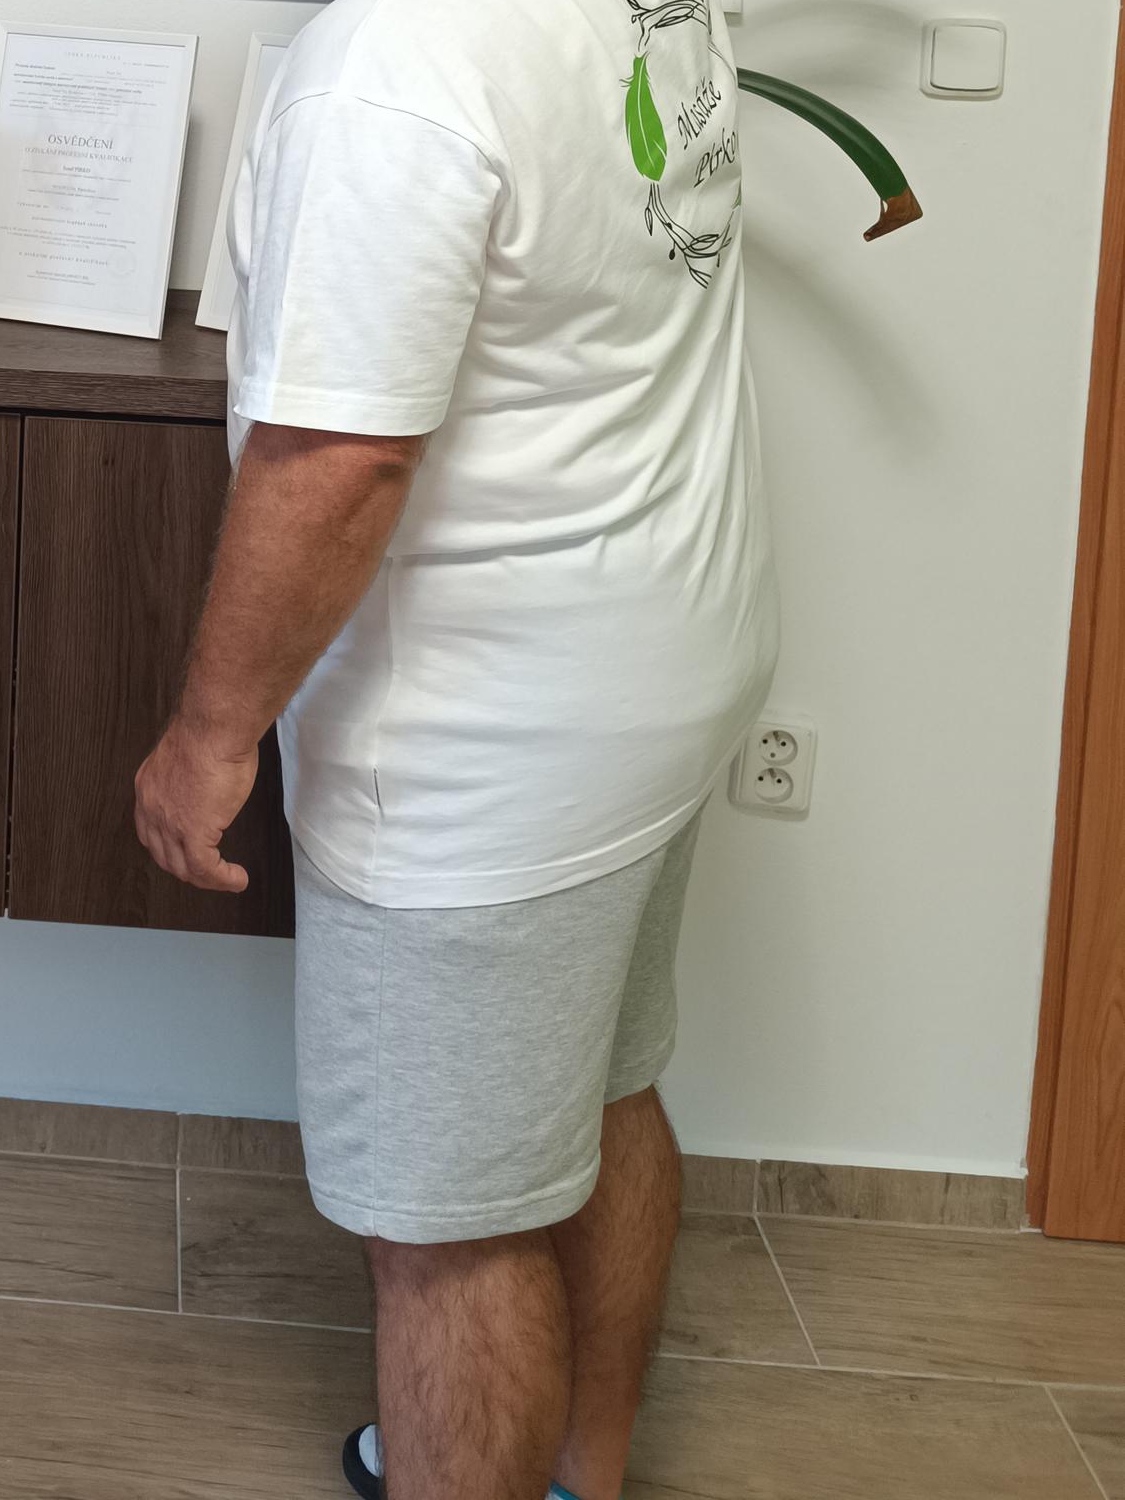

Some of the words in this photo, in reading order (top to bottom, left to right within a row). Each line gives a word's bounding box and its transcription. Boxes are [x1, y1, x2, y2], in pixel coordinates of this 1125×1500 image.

[47, 133, 114, 150] OSVĚDČENÍ
[677, 76, 722, 151] Masáže
[693, 127, 735, 188] Pírko
